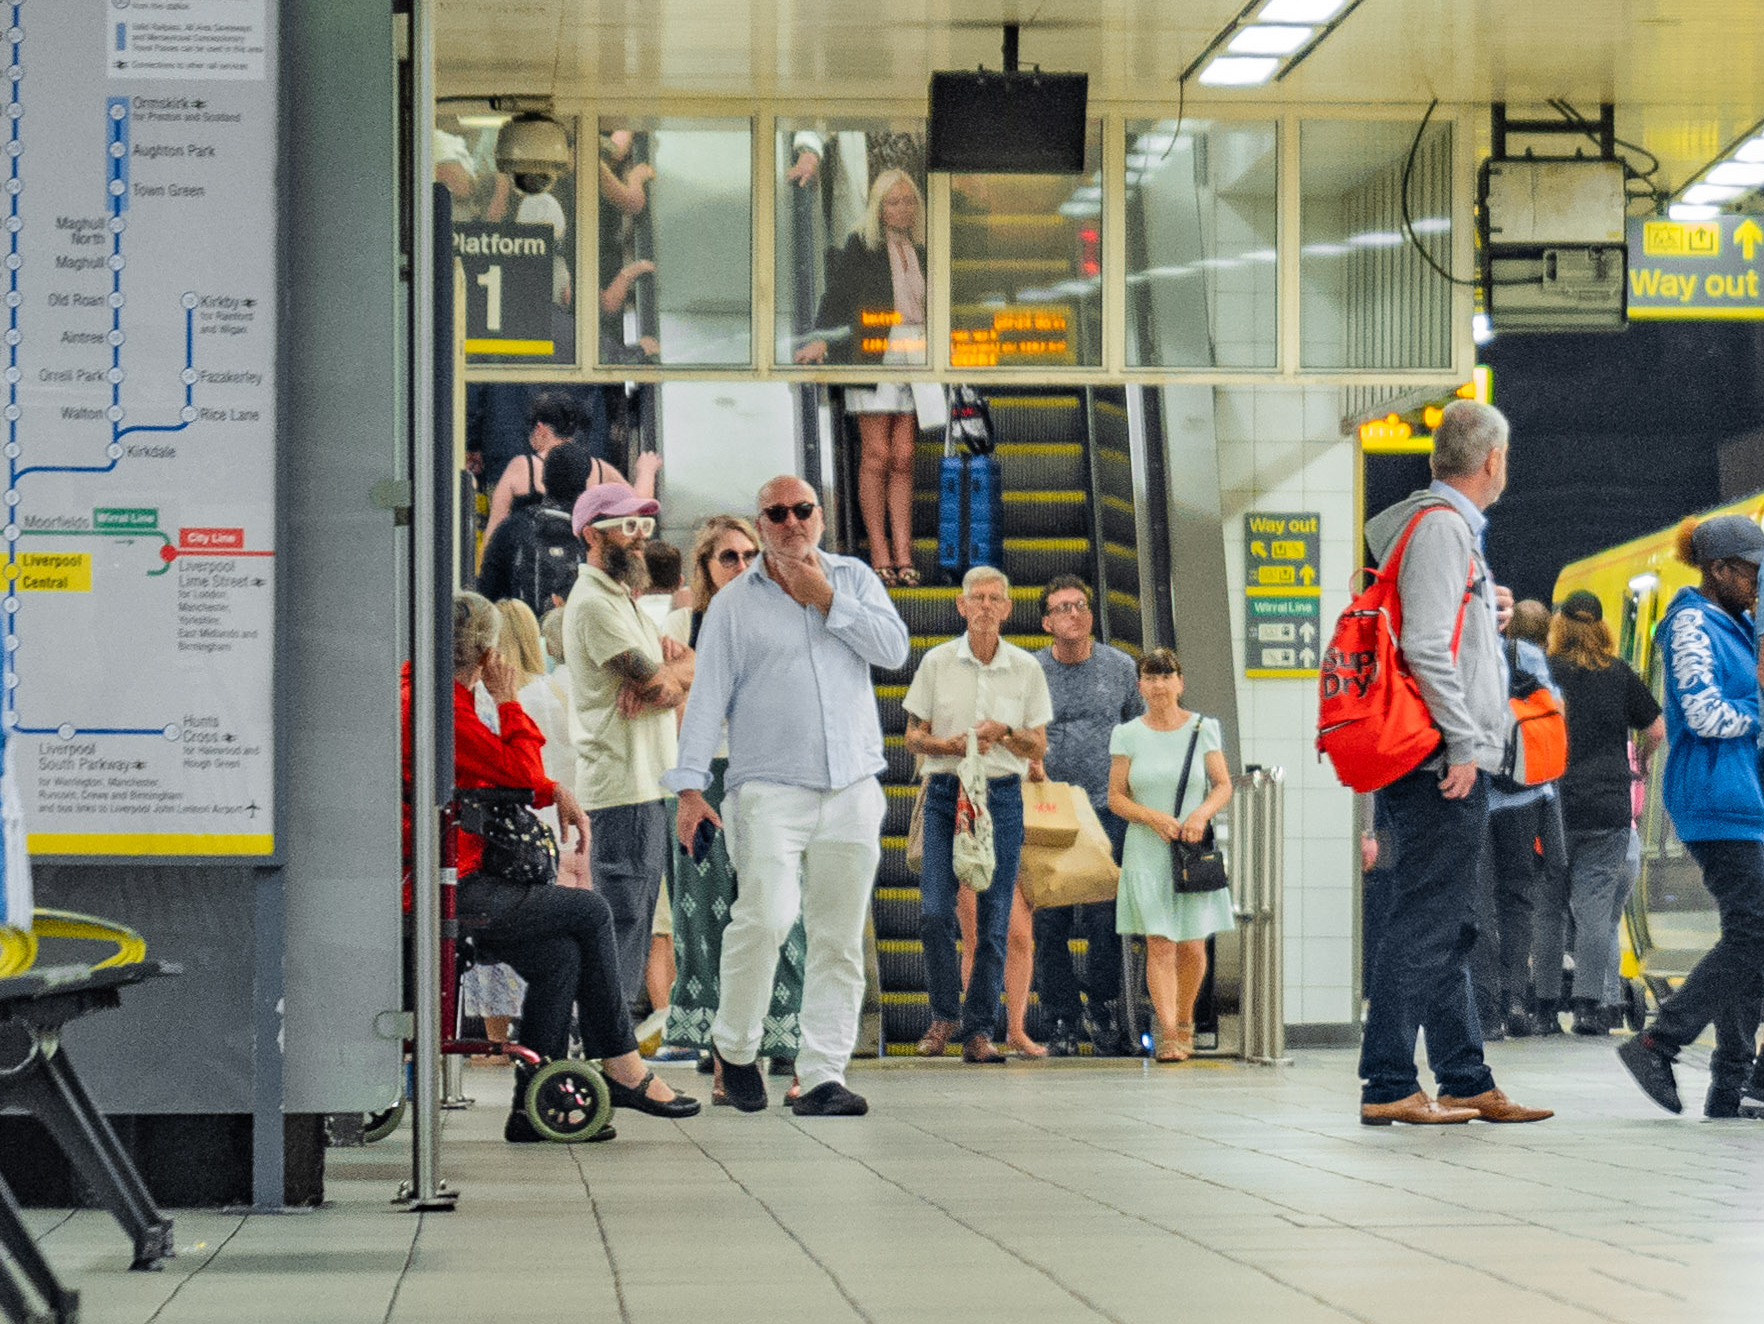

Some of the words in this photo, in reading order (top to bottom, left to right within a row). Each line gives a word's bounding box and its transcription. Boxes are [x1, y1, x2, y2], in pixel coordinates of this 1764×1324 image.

[132, 143, 185, 159] Aughton
[187, 143, 216, 159] Park
[1629, 268, 1698, 303] Way
[1704, 268, 1760, 298] out
[477, 265, 502, 331] 1
[1250, 517, 1286, 535] Way
[1288, 517, 1318, 533] out
[187, 533, 211, 546] City
[212, 533, 237, 545] Line
[22, 554, 82, 568] Liverpool
[178, 560, 237, 575] Liverpool
[22, 576, 69, 590] Central
[1254, 601, 1288, 614] Wirral
[1289, 601, 1313, 613] Line
[38, 742, 97, 759] Liverpool
